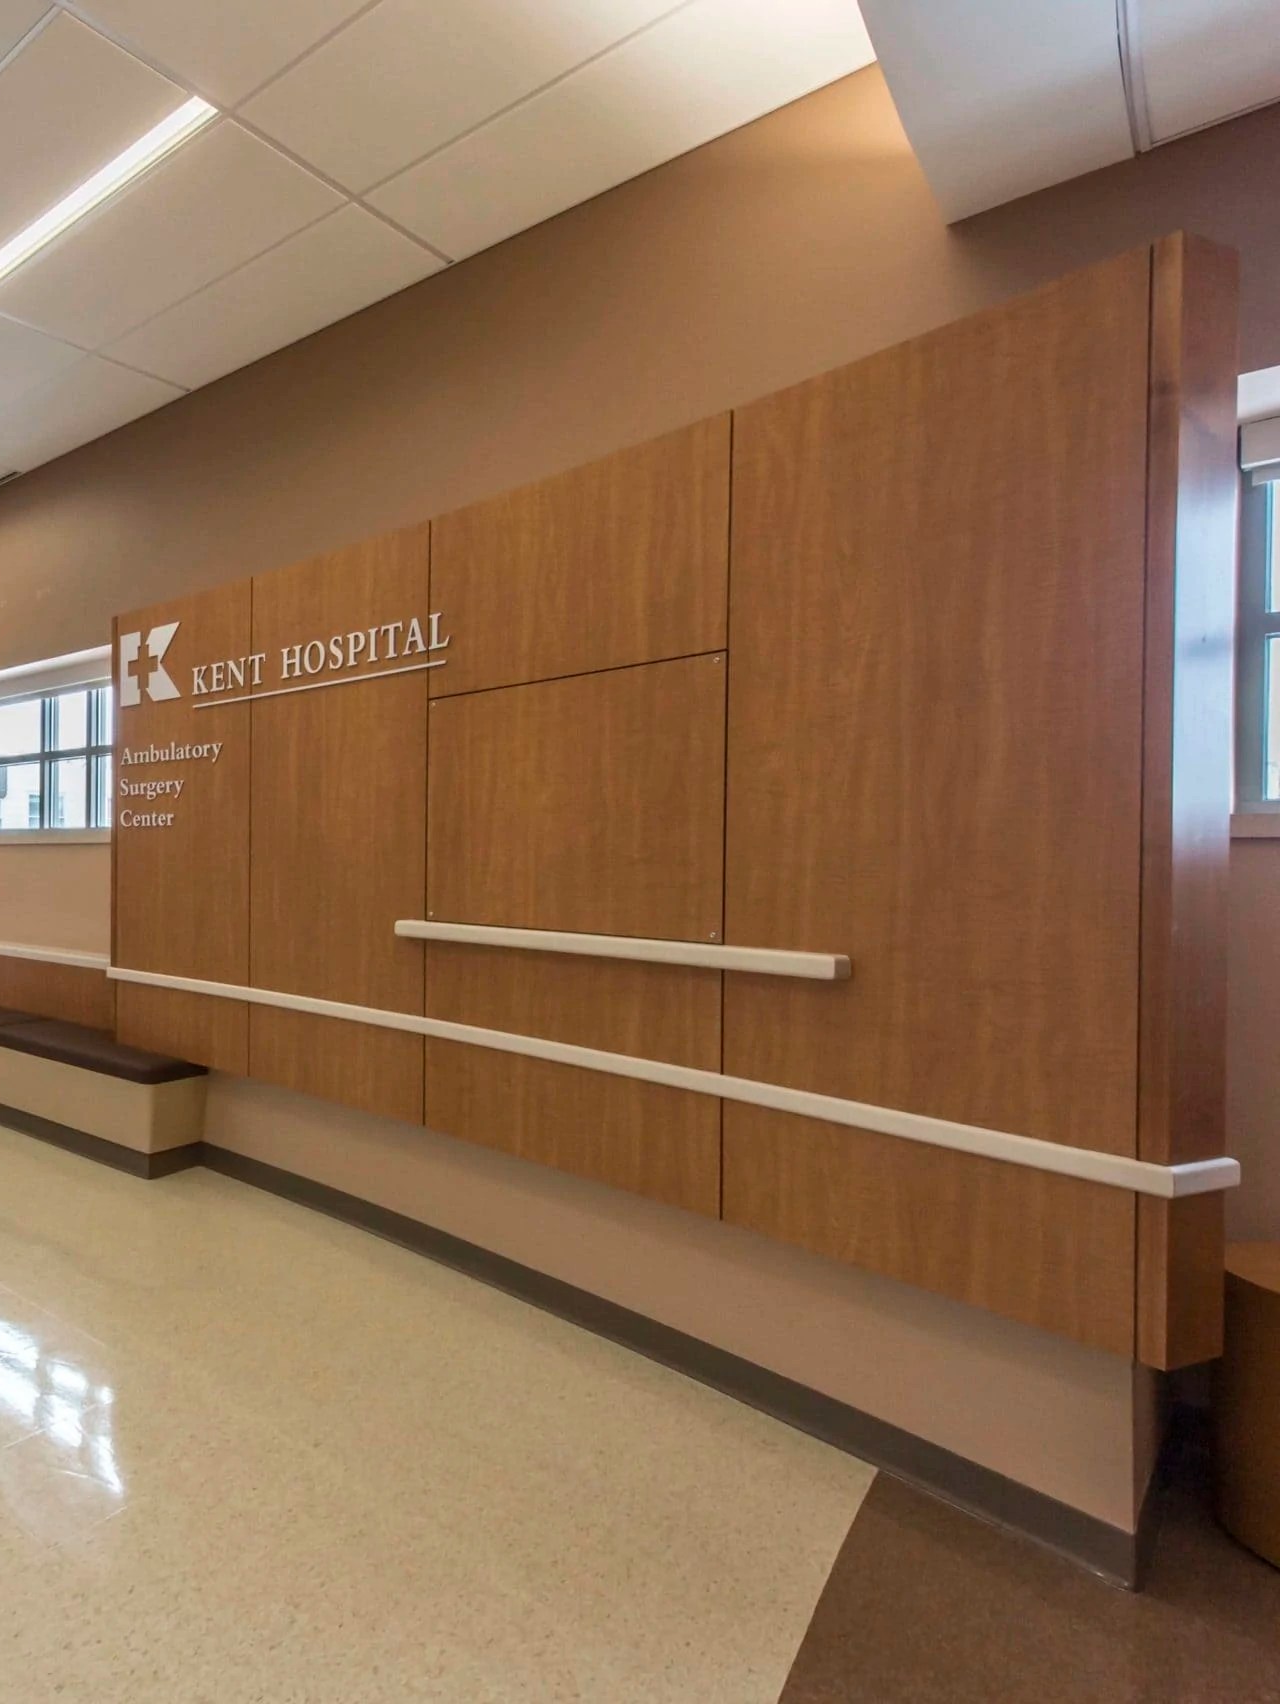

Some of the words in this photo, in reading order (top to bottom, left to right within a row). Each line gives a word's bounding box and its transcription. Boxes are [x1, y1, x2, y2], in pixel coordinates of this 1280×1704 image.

[191, 652, 266, 696] KENT
[280, 612, 451, 680] HOSPITAL
[120, 741, 223, 766] Ambulatory
[120, 778, 185, 800] Surgery
[120, 809, 175, 827] Center
